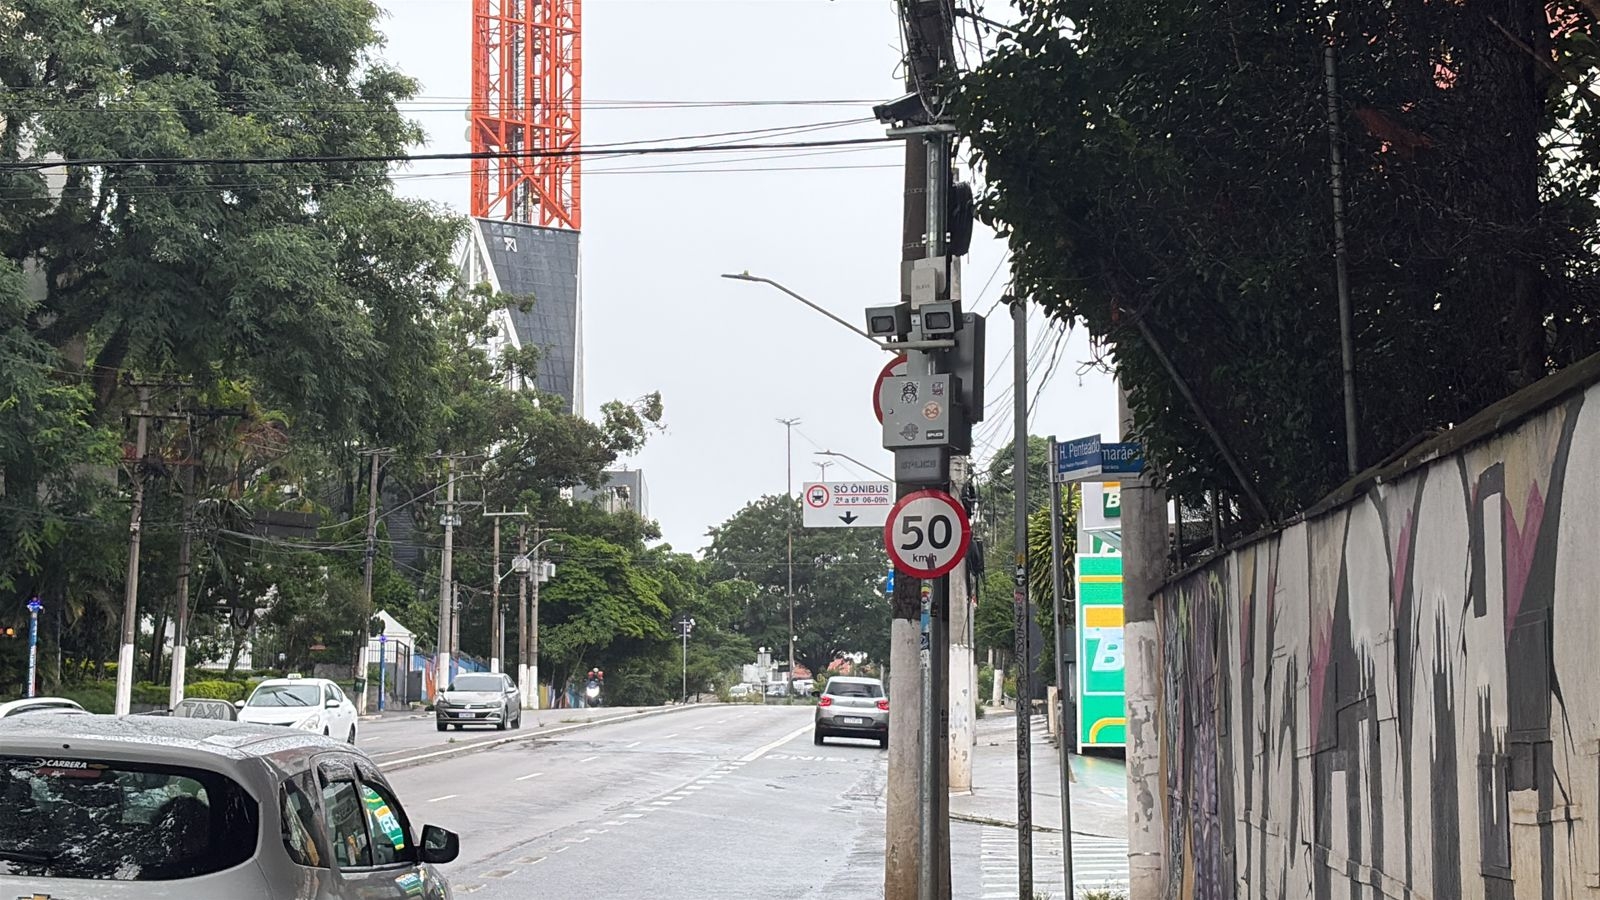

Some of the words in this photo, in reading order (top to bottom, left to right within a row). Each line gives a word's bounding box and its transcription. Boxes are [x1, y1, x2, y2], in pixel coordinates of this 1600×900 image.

[1059, 447, 1068, 460] H.
[1069, 440, 1100, 458] Penteado
[833, 483, 848, 494] SÓ
[851, 483, 889, 494] ÔNIBUS
[901, 514, 952, 550] 50
[182, 703, 225, 720] TAXI
[46, 759, 87, 769] CARRERA
